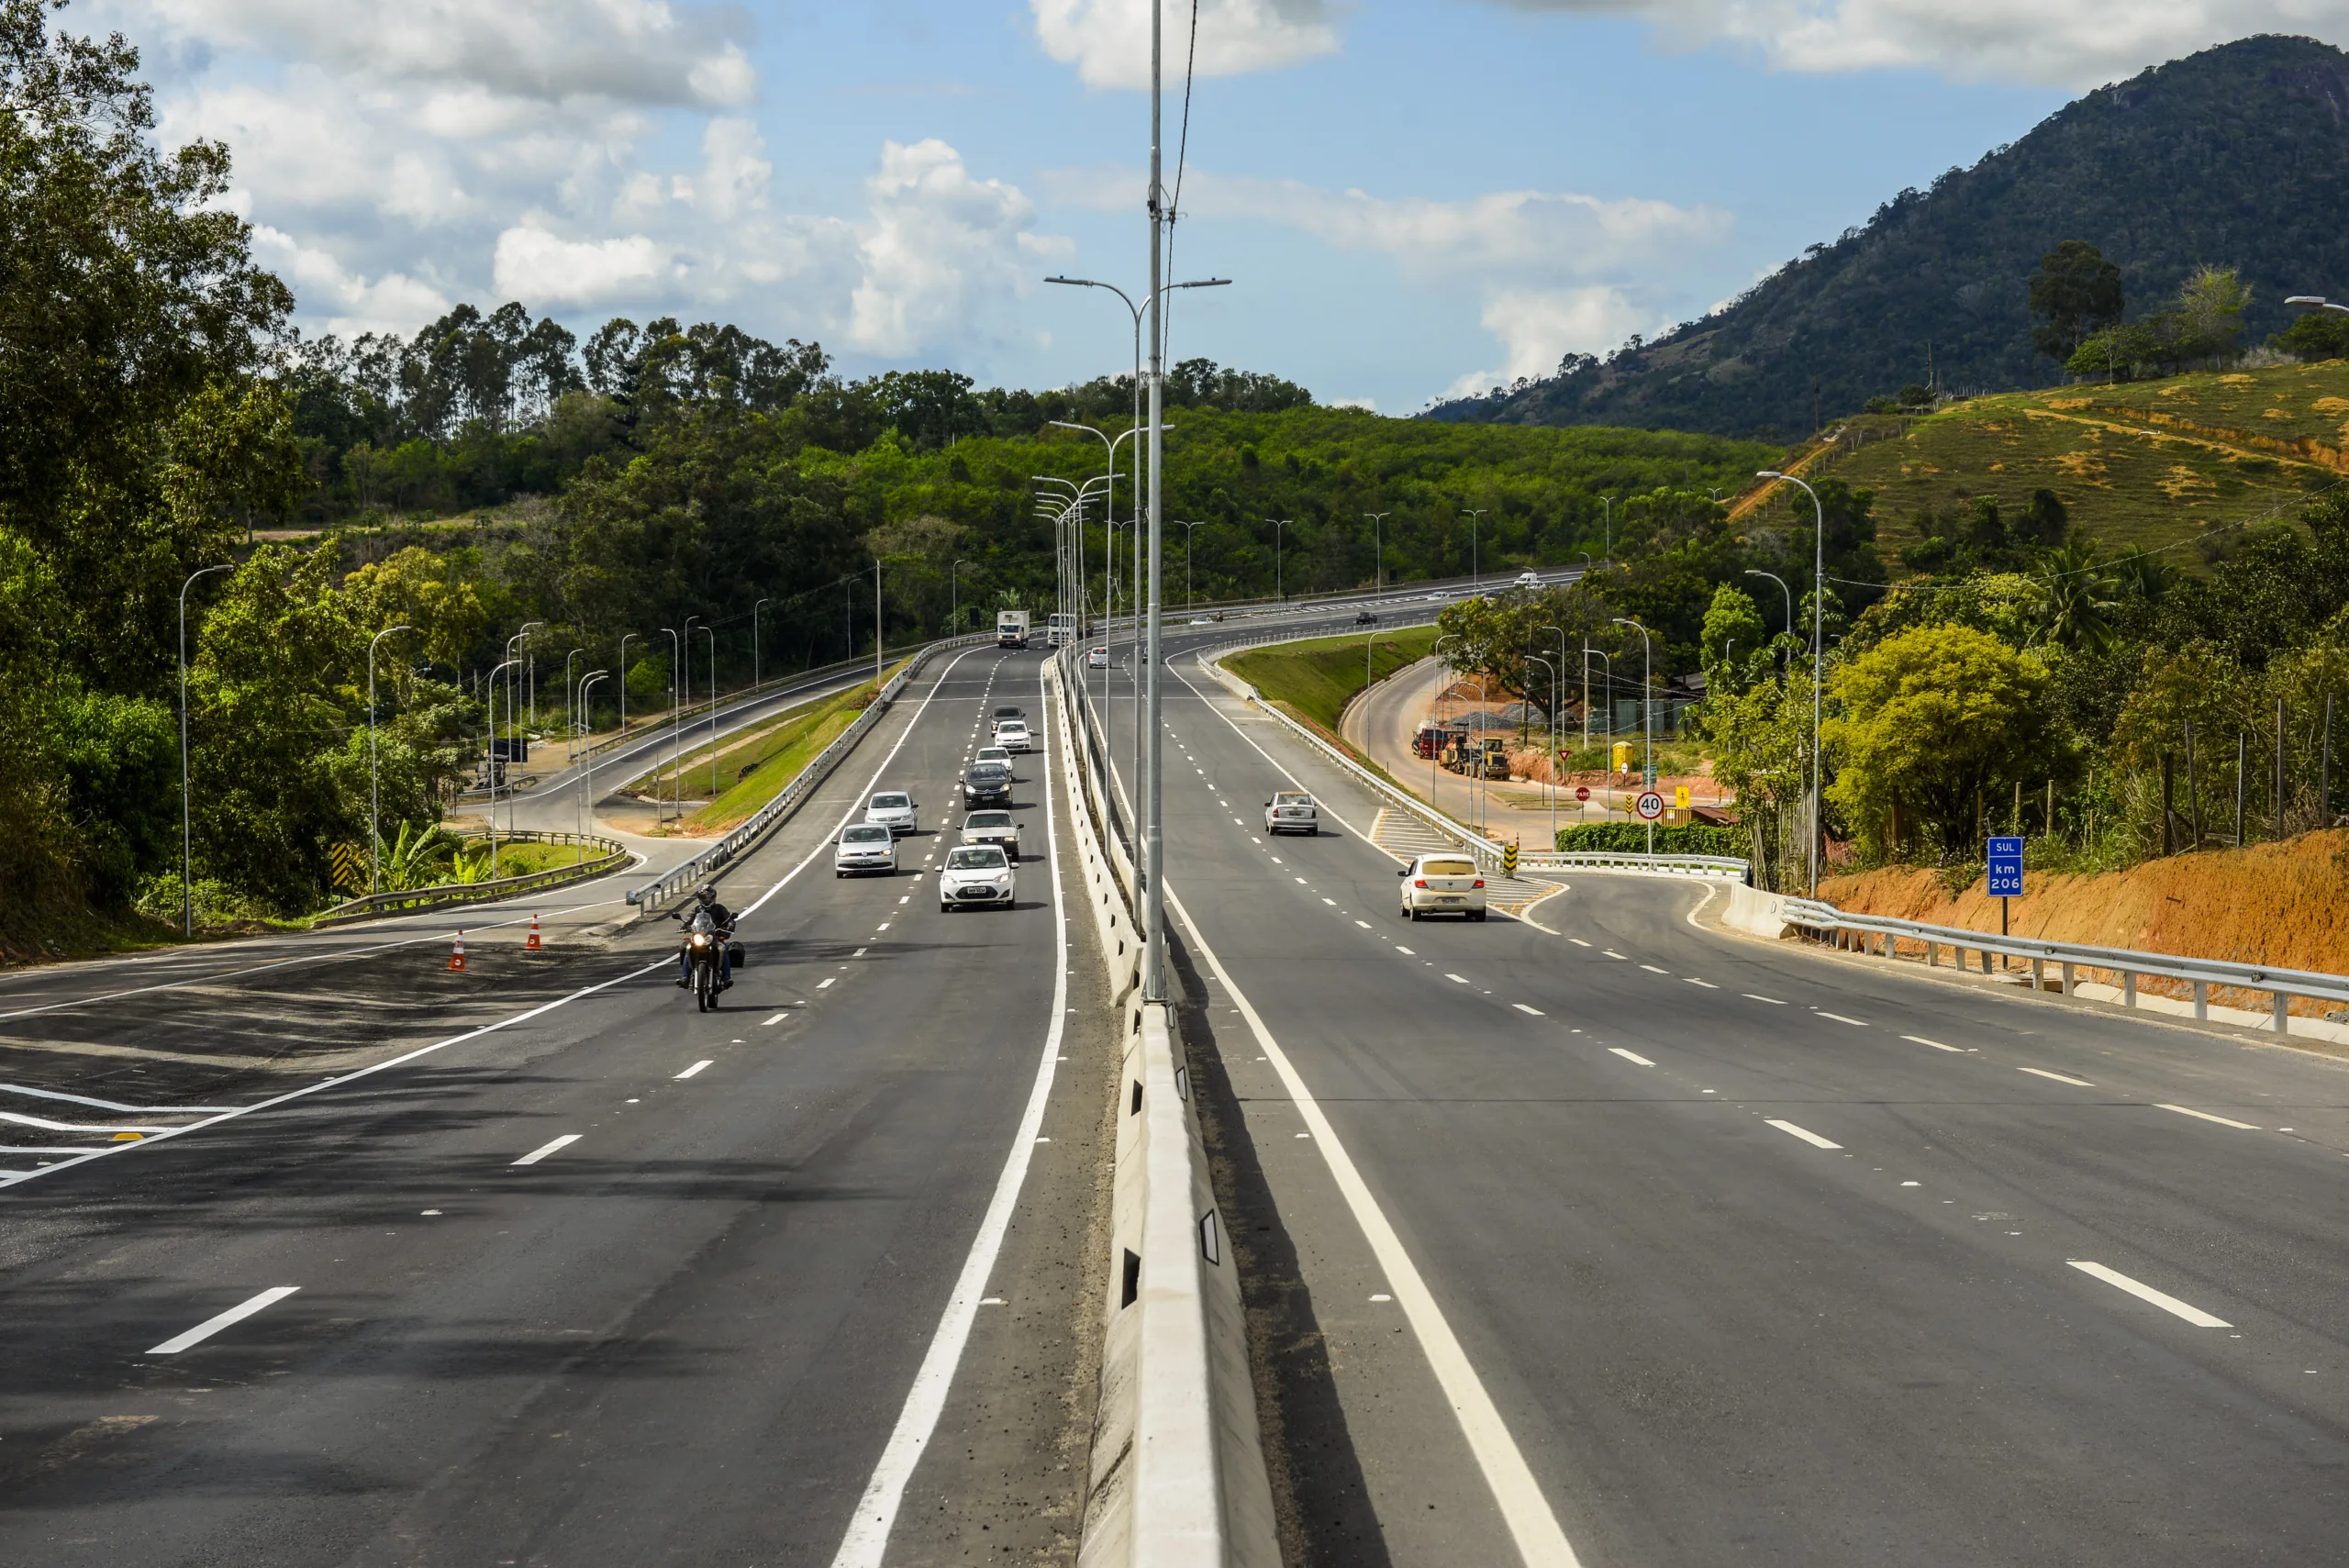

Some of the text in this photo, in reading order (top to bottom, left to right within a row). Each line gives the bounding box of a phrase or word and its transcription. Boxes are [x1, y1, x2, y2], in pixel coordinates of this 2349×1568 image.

[1641, 798, 1659, 810] 40
[1996, 843, 2015, 851] SUL
[1996, 864, 2015, 874] km
[1991, 879, 2020, 889] 206
